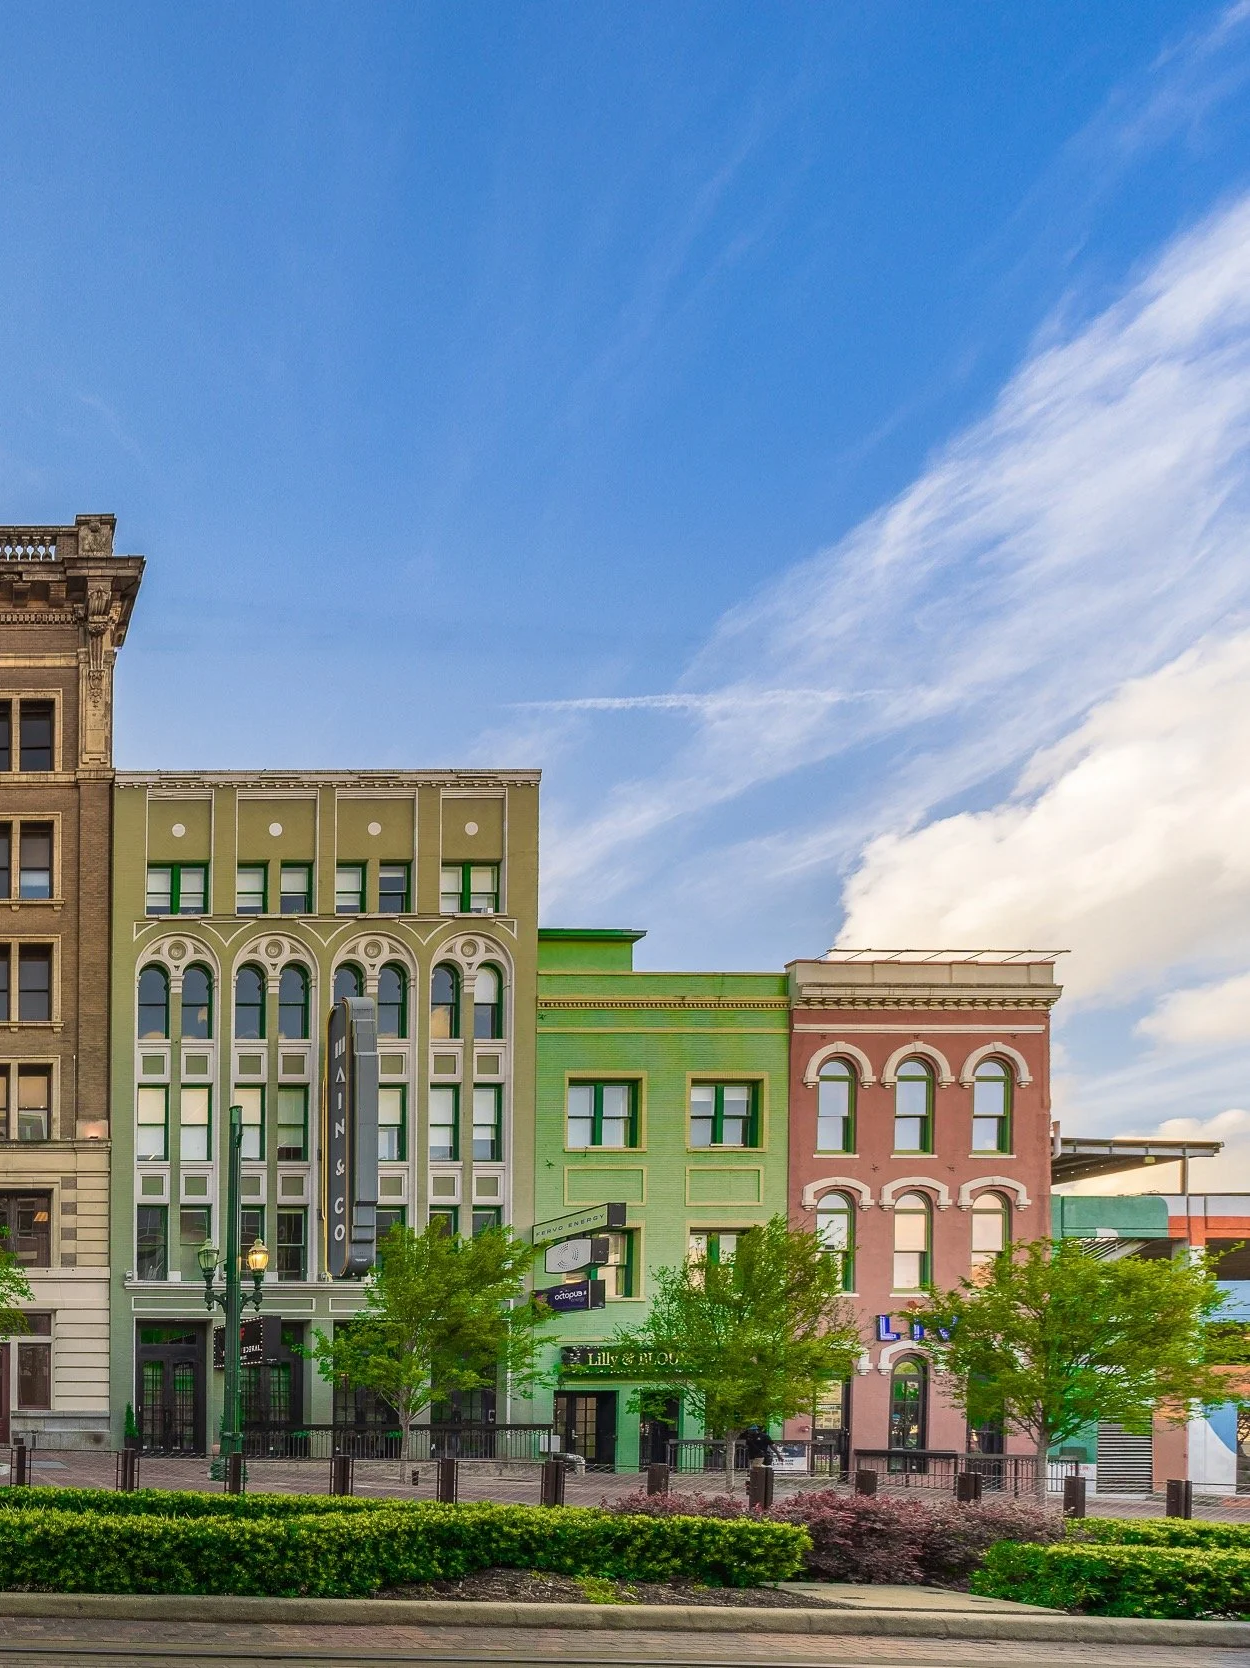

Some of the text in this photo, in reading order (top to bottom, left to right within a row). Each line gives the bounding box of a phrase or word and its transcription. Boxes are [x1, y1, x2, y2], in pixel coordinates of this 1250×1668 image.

[335, 1158, 345, 1177] &
[334, 1196, 346, 1242] CO
[535, 1213, 605, 1238] FERVO ENERGY
[554, 1290, 583, 1301] octopus
[587, 1351, 618, 1368] Lilly
[622, 1352, 635, 1366] &
